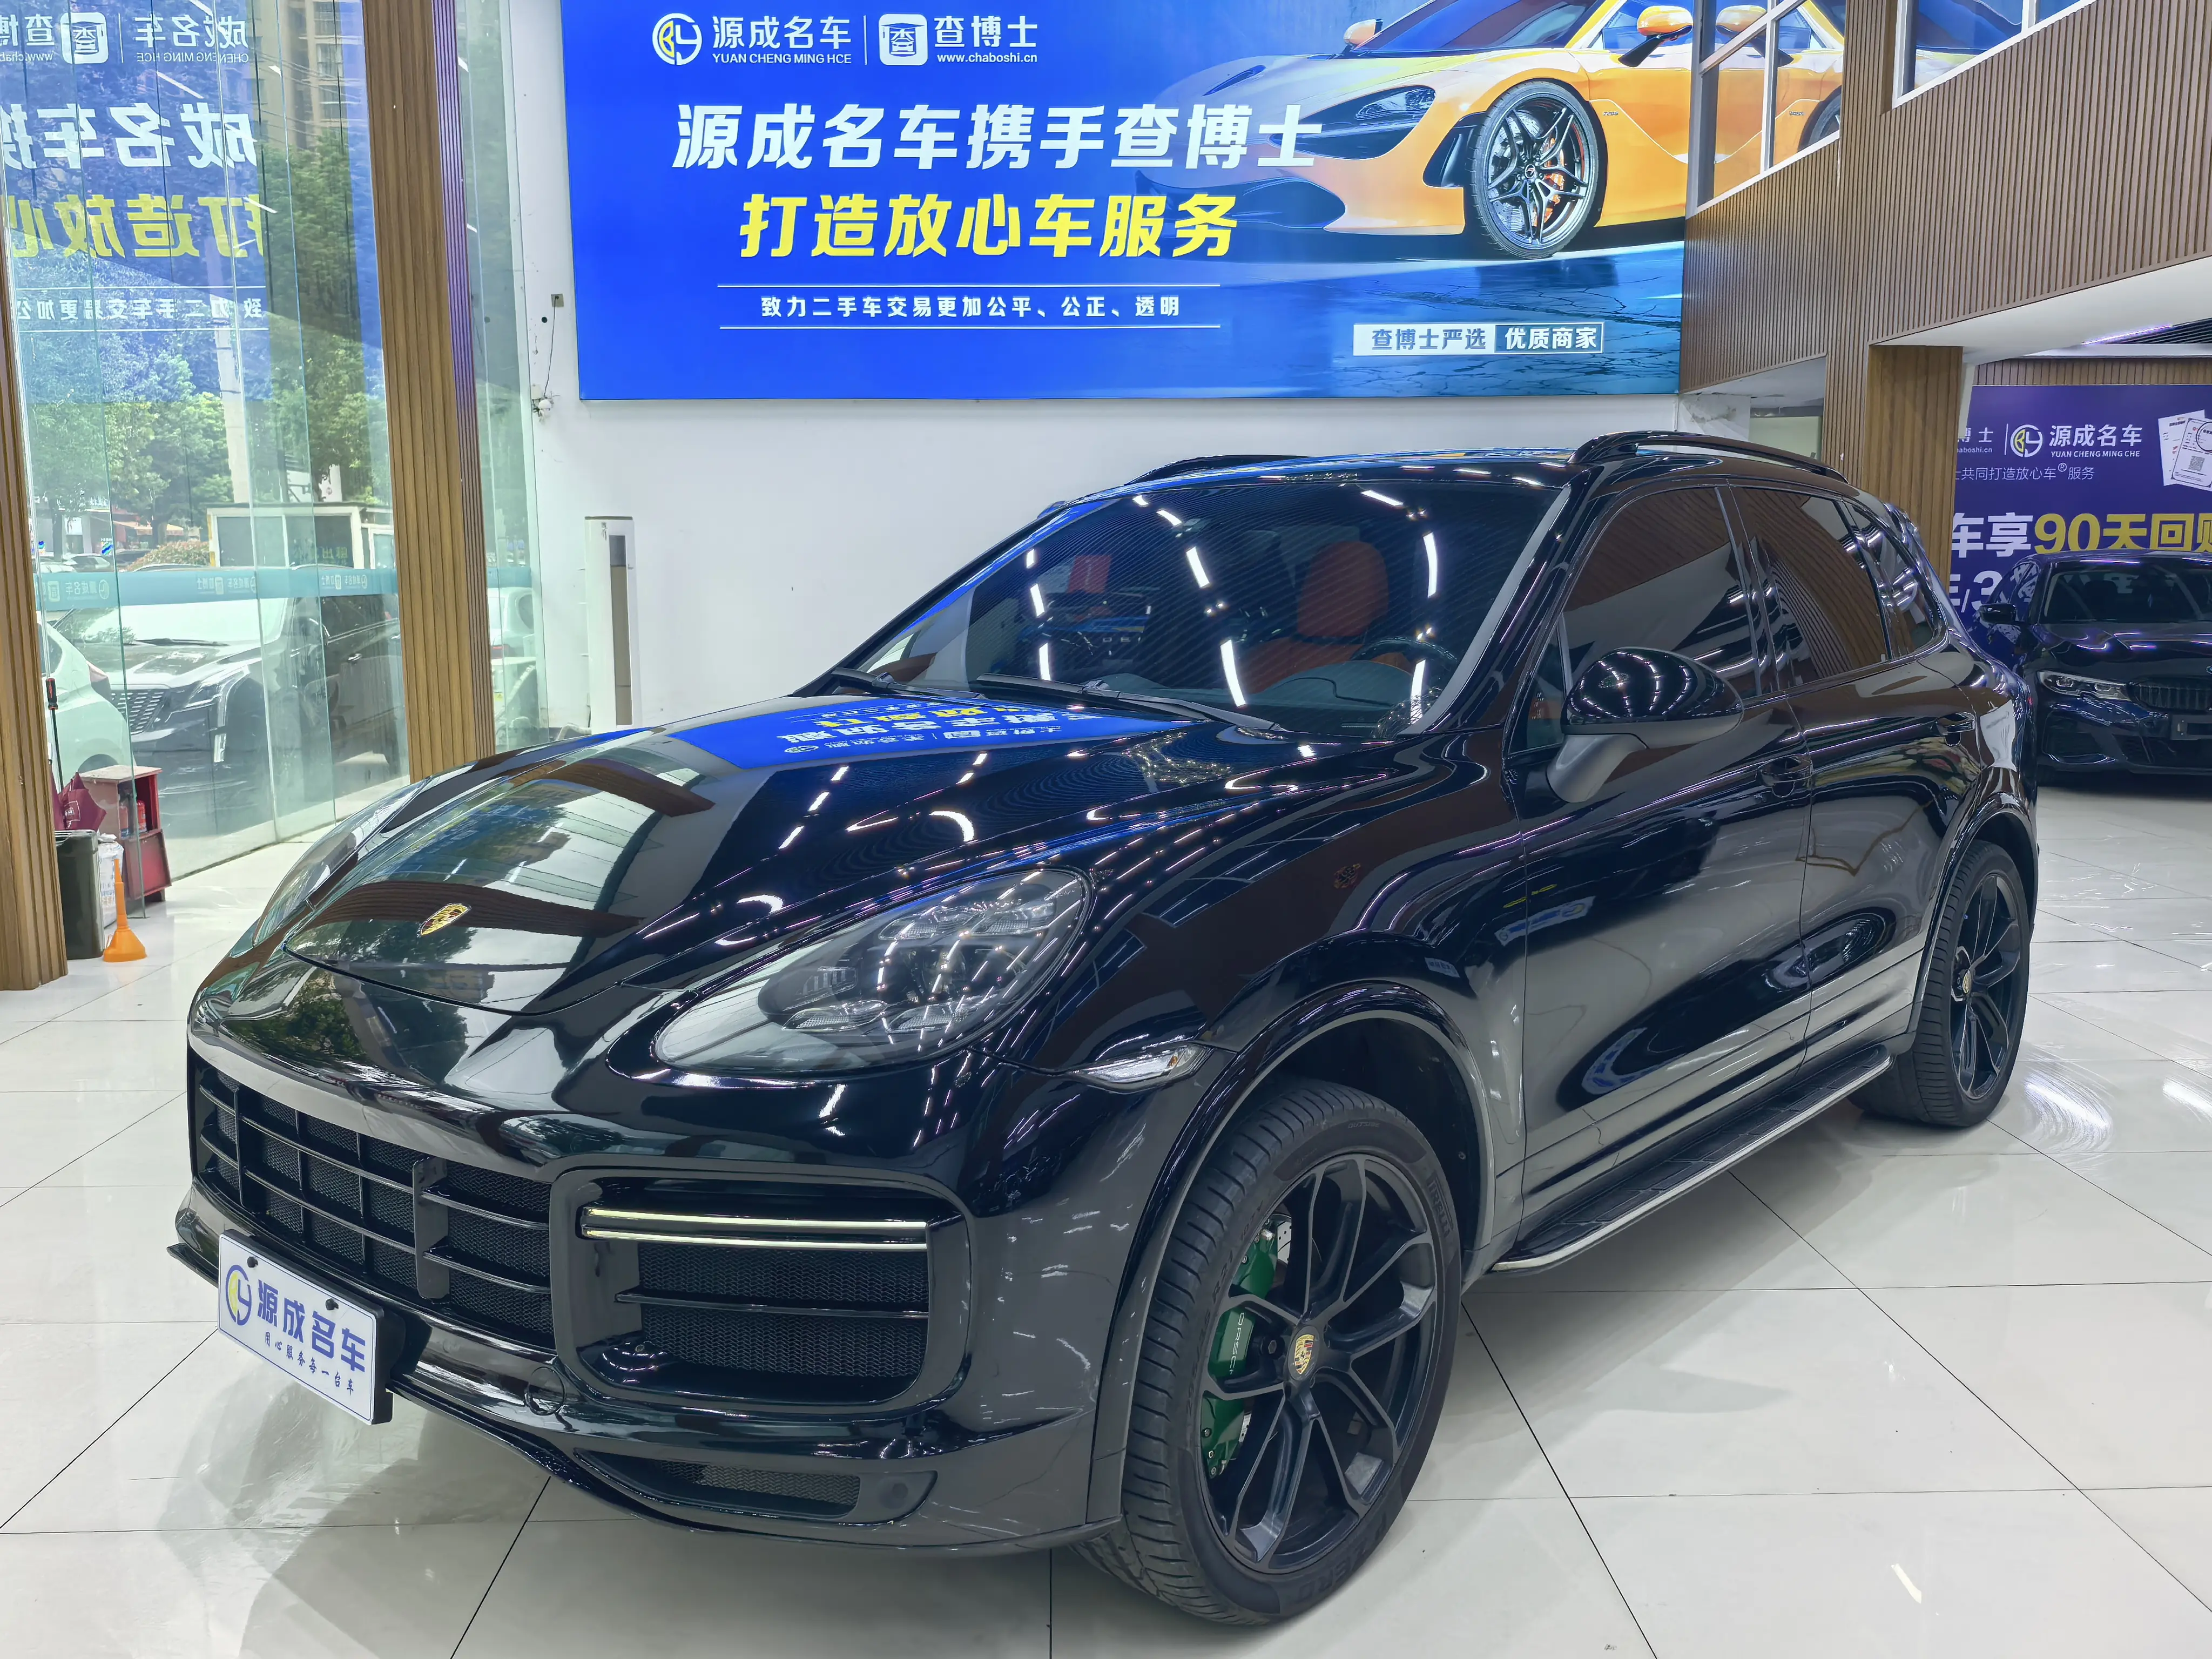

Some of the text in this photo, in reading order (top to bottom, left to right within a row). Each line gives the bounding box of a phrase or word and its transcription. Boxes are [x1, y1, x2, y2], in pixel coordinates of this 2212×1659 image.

[713, 15, 852, 49] 源成名车
[934, 15, 1038, 48] 查博士
[712, 53, 852, 64] YUAN CHENG MING HCE
[937, 52, 1037, 63] www.chaboshi.cn
[672, 103, 1323, 170] 源成名车携手查博士
[740, 194, 1238, 258] 打造放心车服务
[761, 295, 1179, 318] 致力二手车交易更加公平、公正、透明
[1372, 326, 1597, 350] 查博士严选 优质商家
[2049, 424, 2143, 447] 源成名车
[257, 1279, 366, 1373] 源成名车
